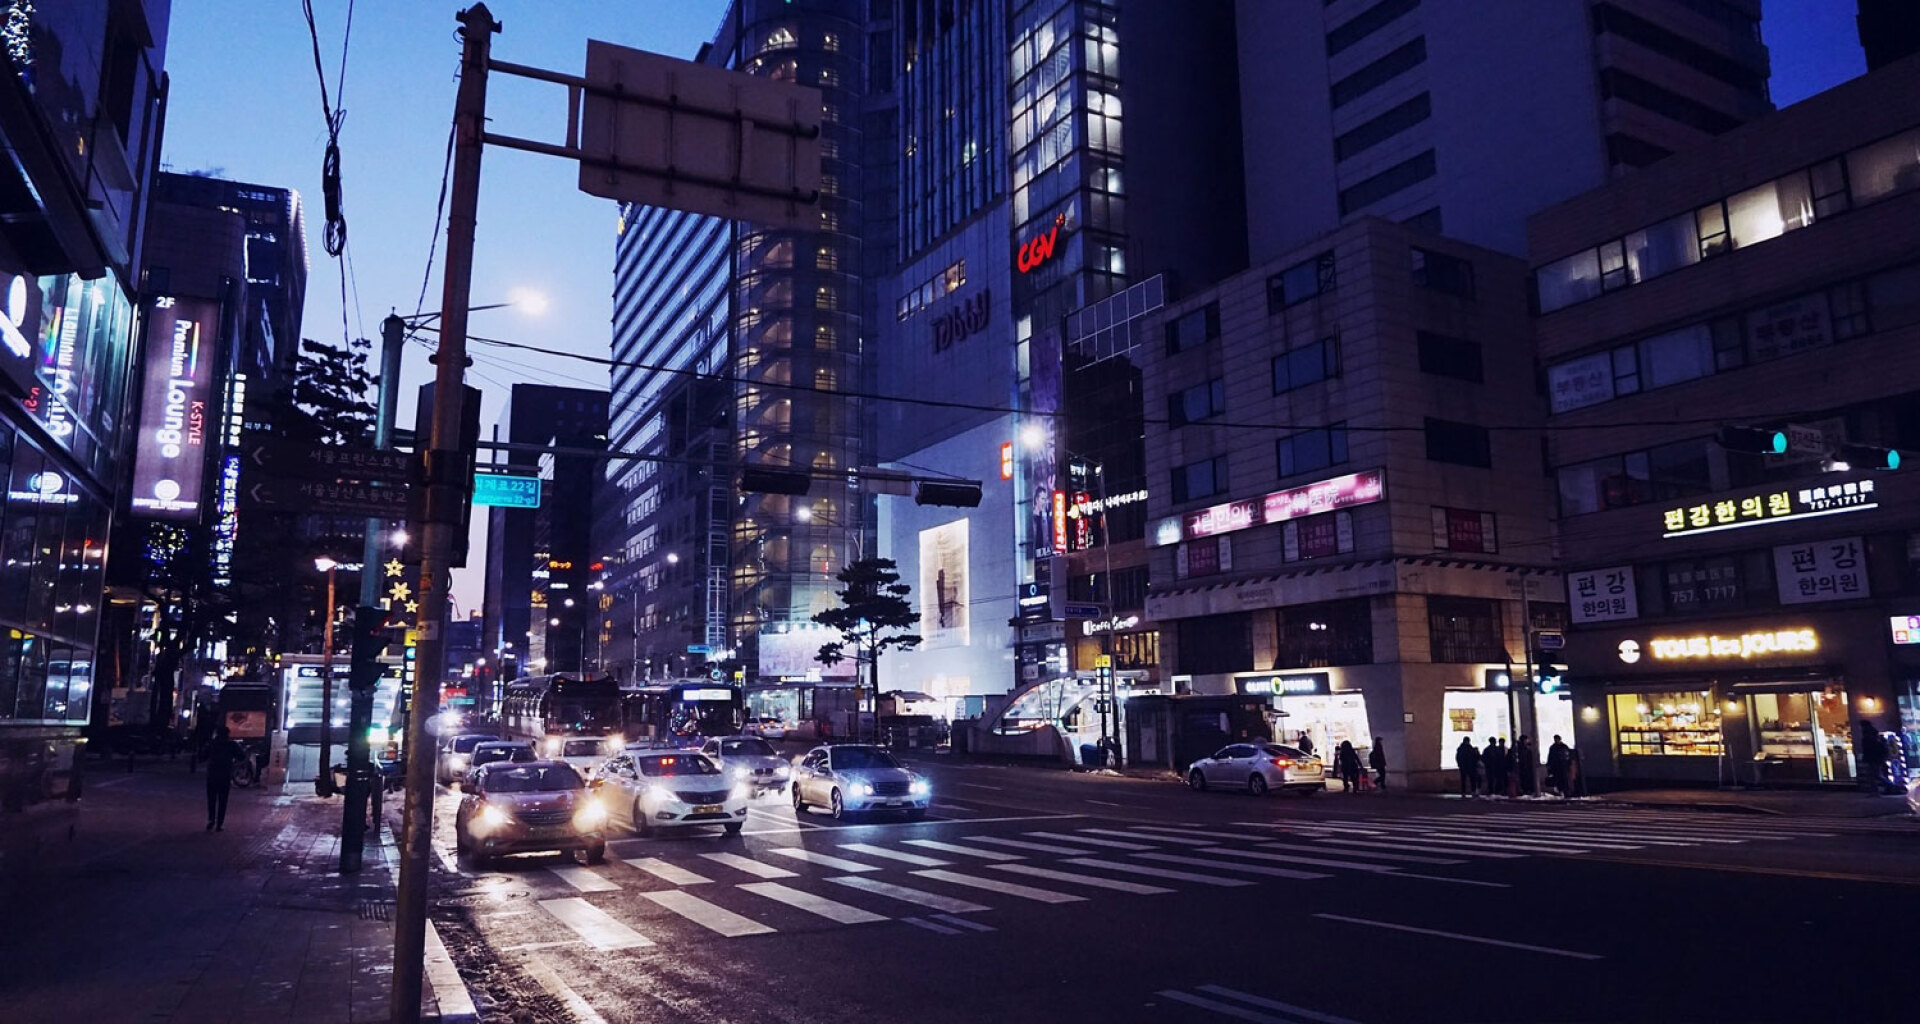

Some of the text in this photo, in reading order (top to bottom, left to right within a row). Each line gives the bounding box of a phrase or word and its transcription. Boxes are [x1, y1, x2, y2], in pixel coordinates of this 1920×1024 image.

[1017, 227, 1058, 273] CGV
[156, 296, 175, 308] 2F
[156, 319, 194, 458] Premium Lounge
[188, 400, 204, 445] K-STYLE
[1664, 492, 1791, 531] 편강한의원
[1810, 494, 1866, 510] 757-1717
[1798, 573, 1860, 596] 한의원
[1582, 597, 1627, 618] 한의원
[1650, 630, 1817, 659] TOUS les JOURS
